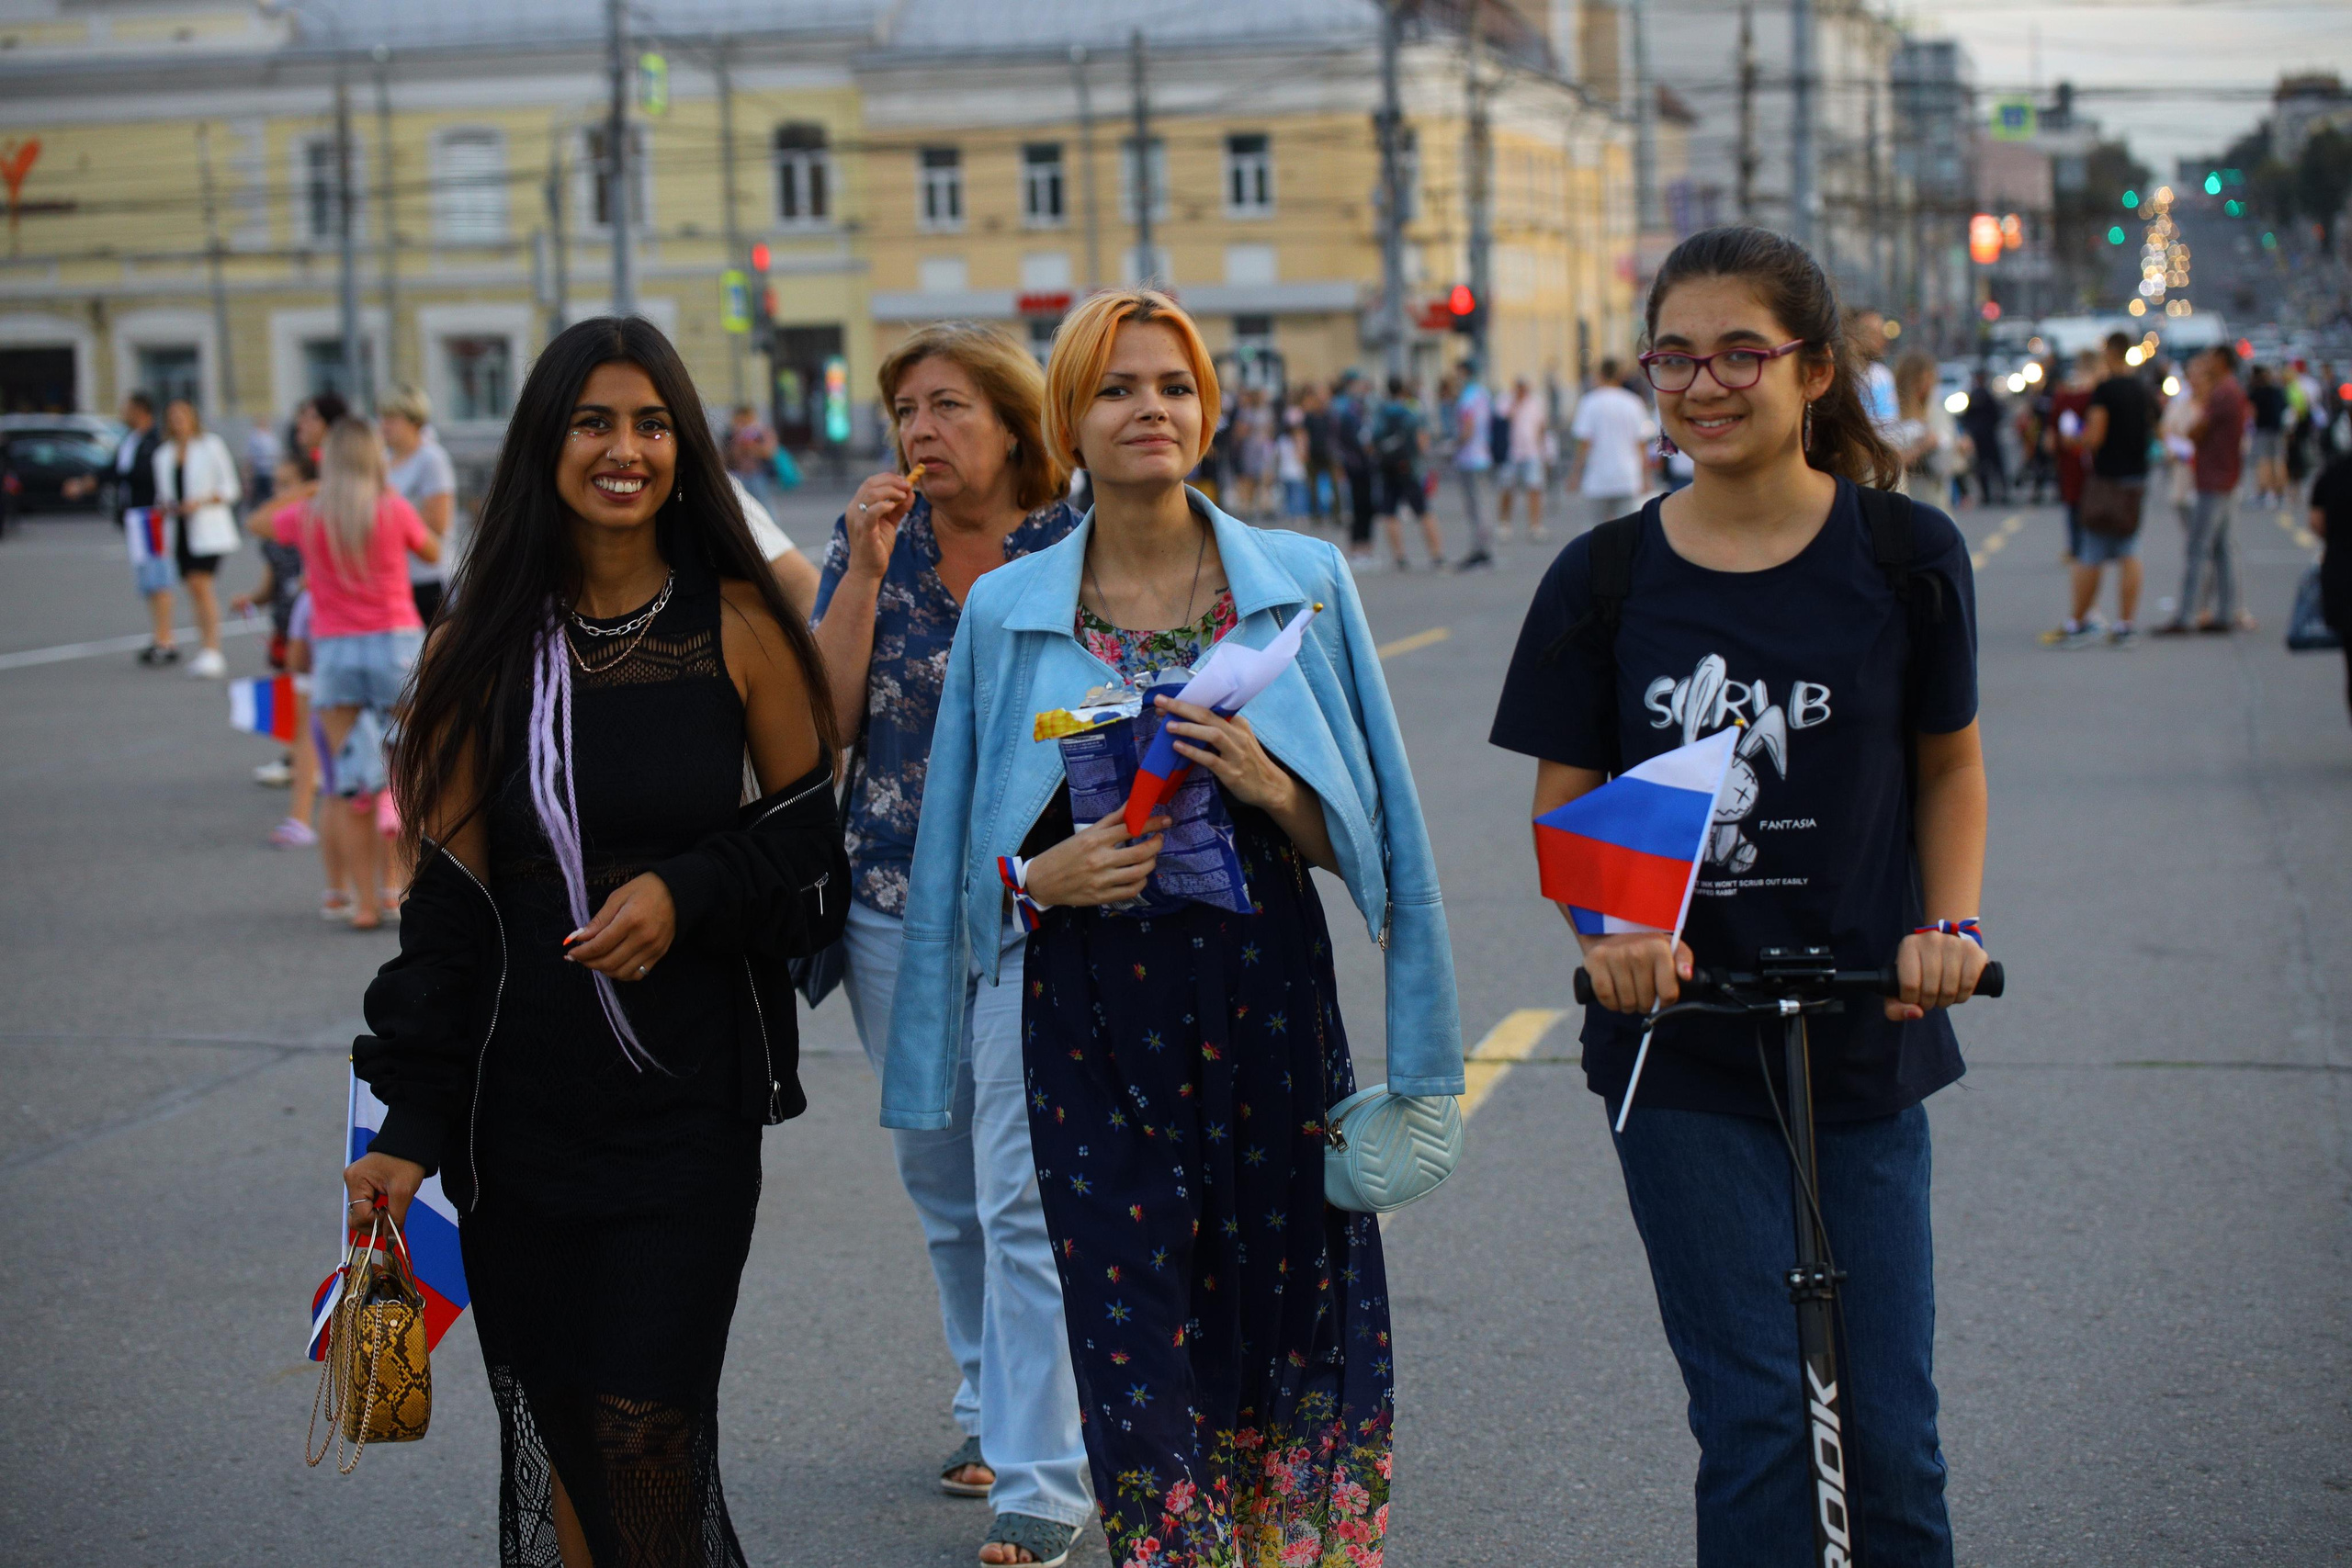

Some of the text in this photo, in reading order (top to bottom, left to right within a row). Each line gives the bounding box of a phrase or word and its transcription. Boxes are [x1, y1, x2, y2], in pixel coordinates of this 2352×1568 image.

[1758, 818, 1817, 830] FANTASIA
[1738, 878, 1764, 887] SCRUB
[1765, 878, 1781, 886] OUT
[1781, 877, 1809, 886] EASILY
